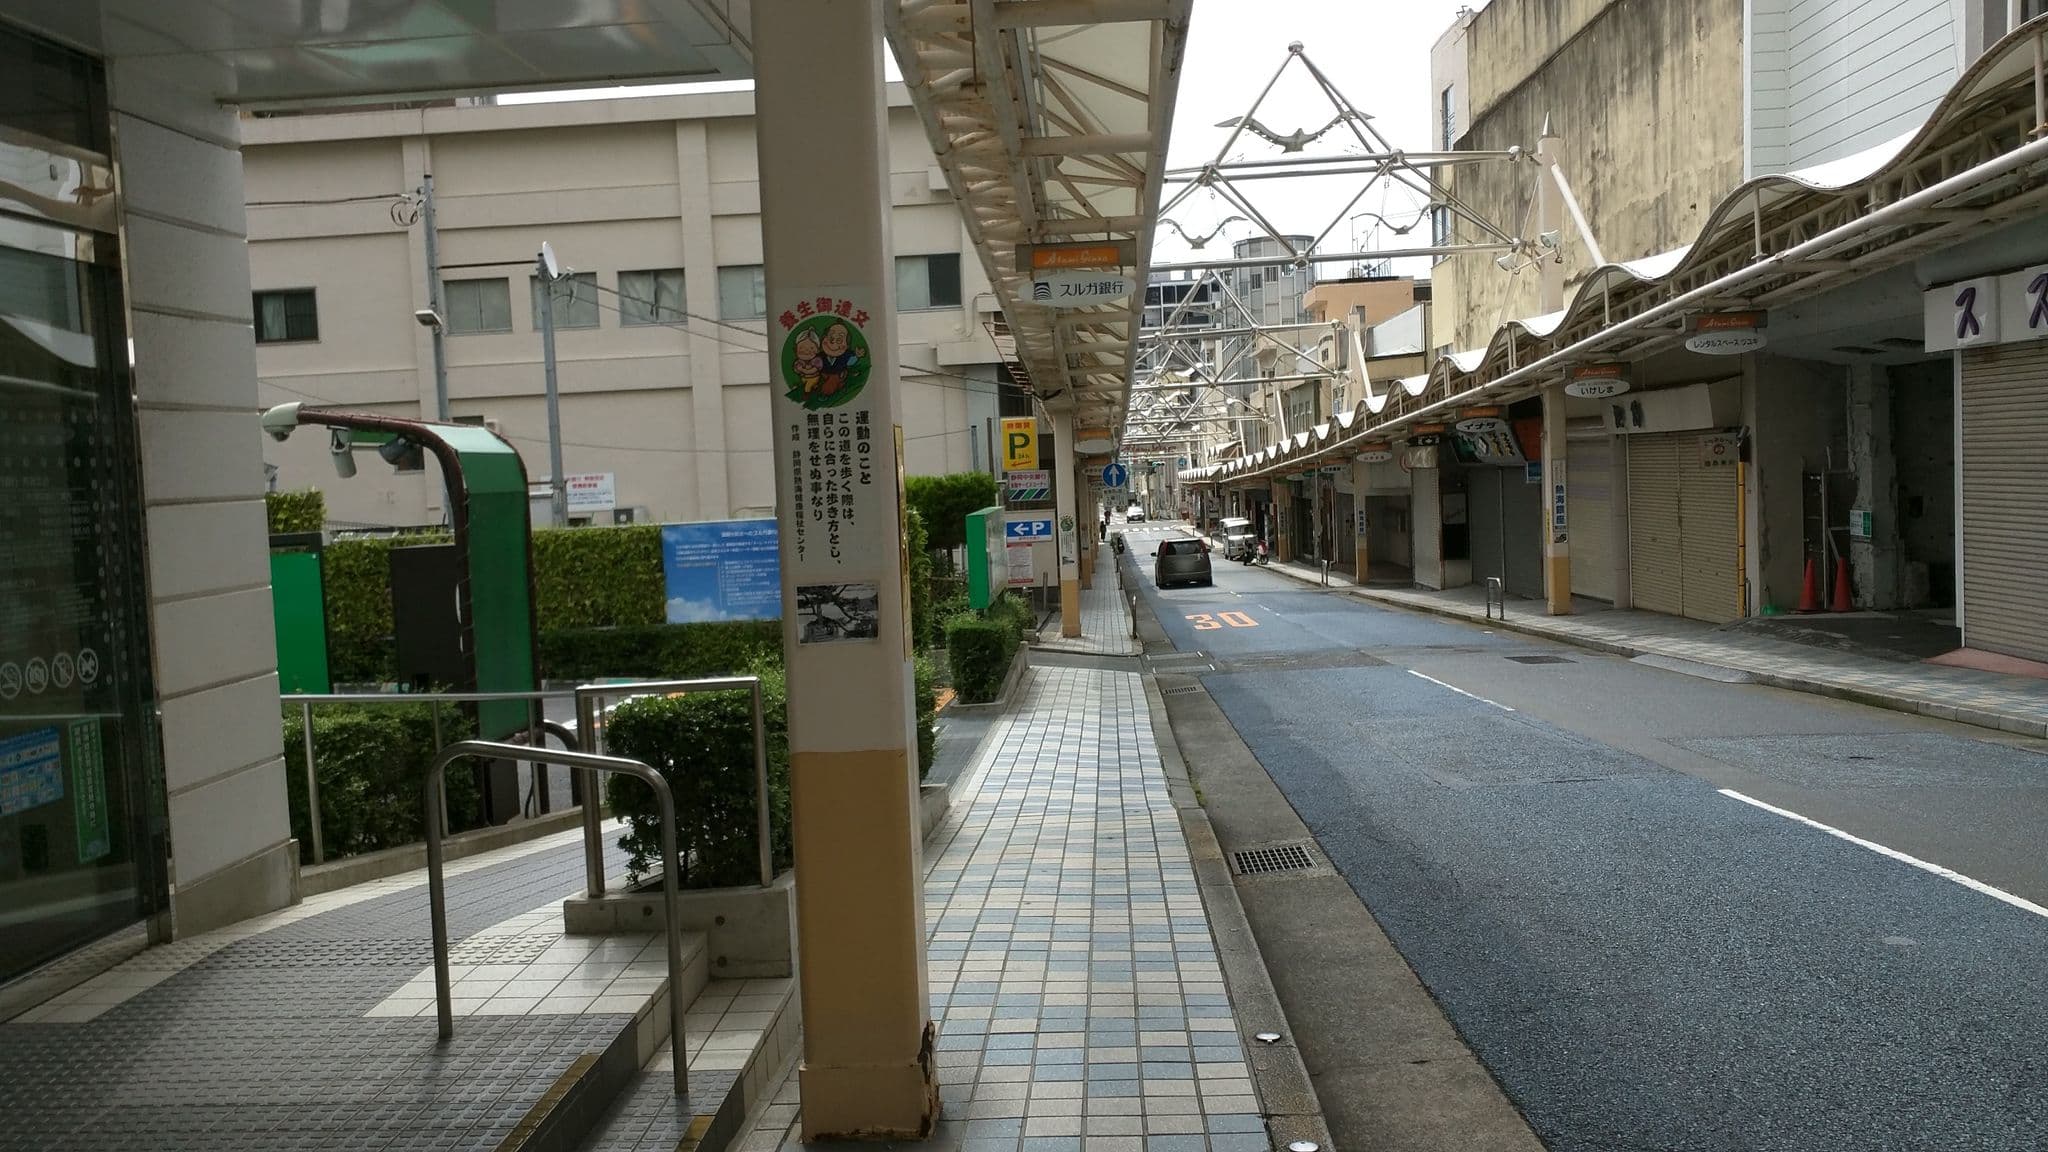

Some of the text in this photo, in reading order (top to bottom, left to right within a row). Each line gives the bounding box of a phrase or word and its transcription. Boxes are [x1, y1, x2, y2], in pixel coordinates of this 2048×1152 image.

[1060, 281, 1124, 297] スルガ銀行
[1580, 386, 1614, 395] いけしま
[855, 410, 871, 485] 運動のこと
[1009, 432, 1031, 460] P
[807, 413, 823, 521] 無理をせぬ事なり
[838, 413, 854, 526] この道を歩く際は、
[823, 413, 841, 564] 自らに合った歩き方とし、
[1032, 522, 1045, 535] P
[1185, 610, 1260, 631] 30
